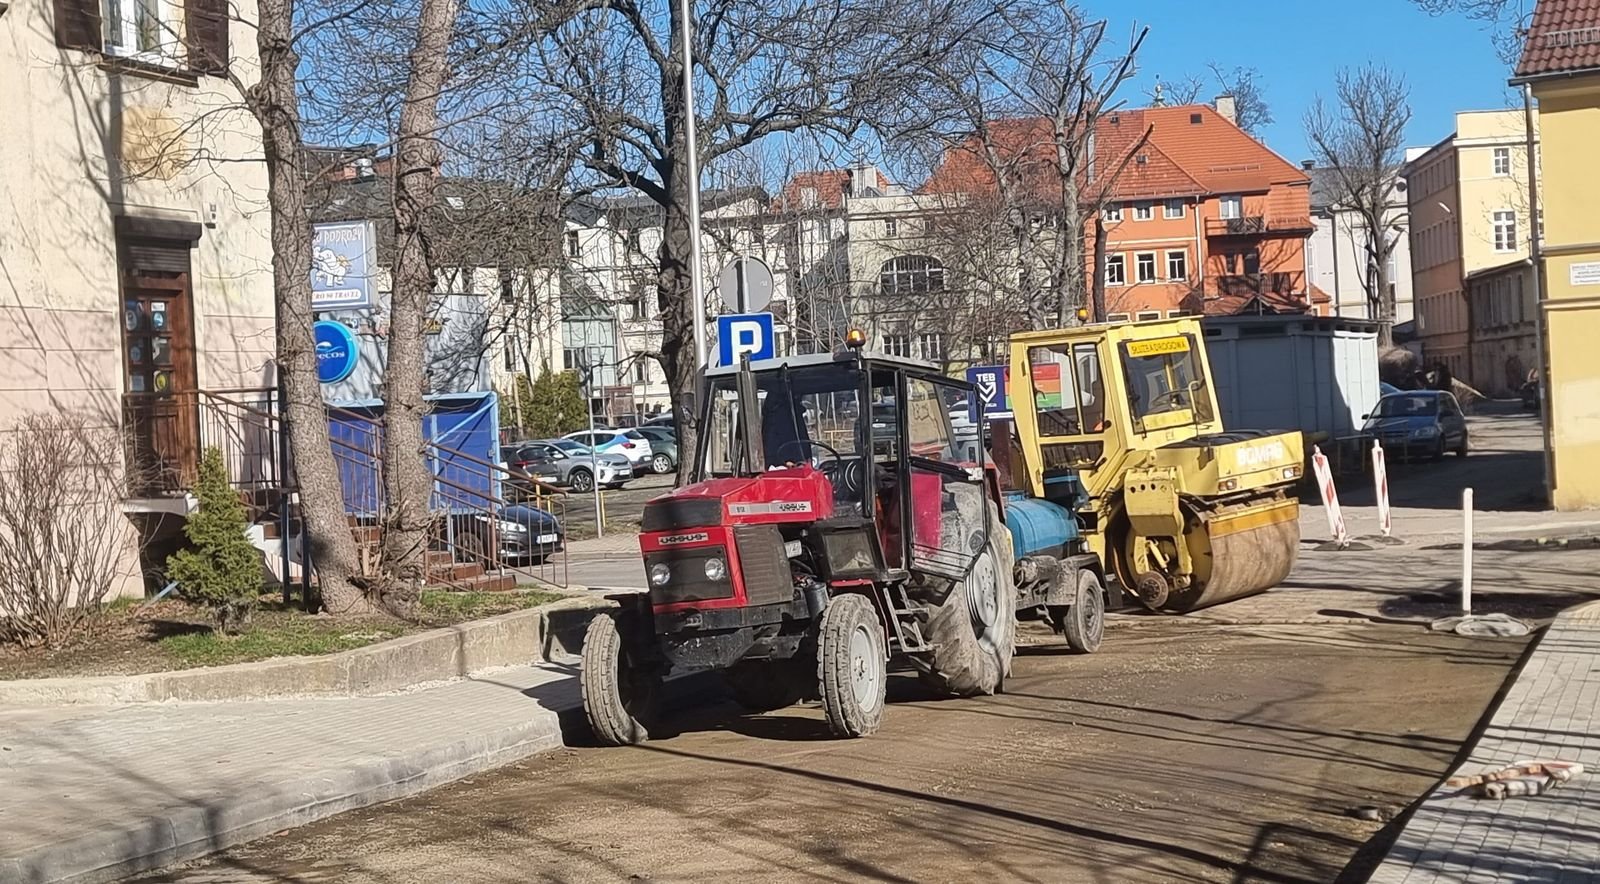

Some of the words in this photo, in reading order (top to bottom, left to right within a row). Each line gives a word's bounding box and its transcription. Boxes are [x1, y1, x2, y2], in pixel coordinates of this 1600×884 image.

[730, 320, 763, 365] P
[976, 373, 996, 382] TEB
[1236, 443, 1283, 466] BOMAG
[779, 503, 807, 511] URSUS
[660, 533, 707, 544] URSUS
